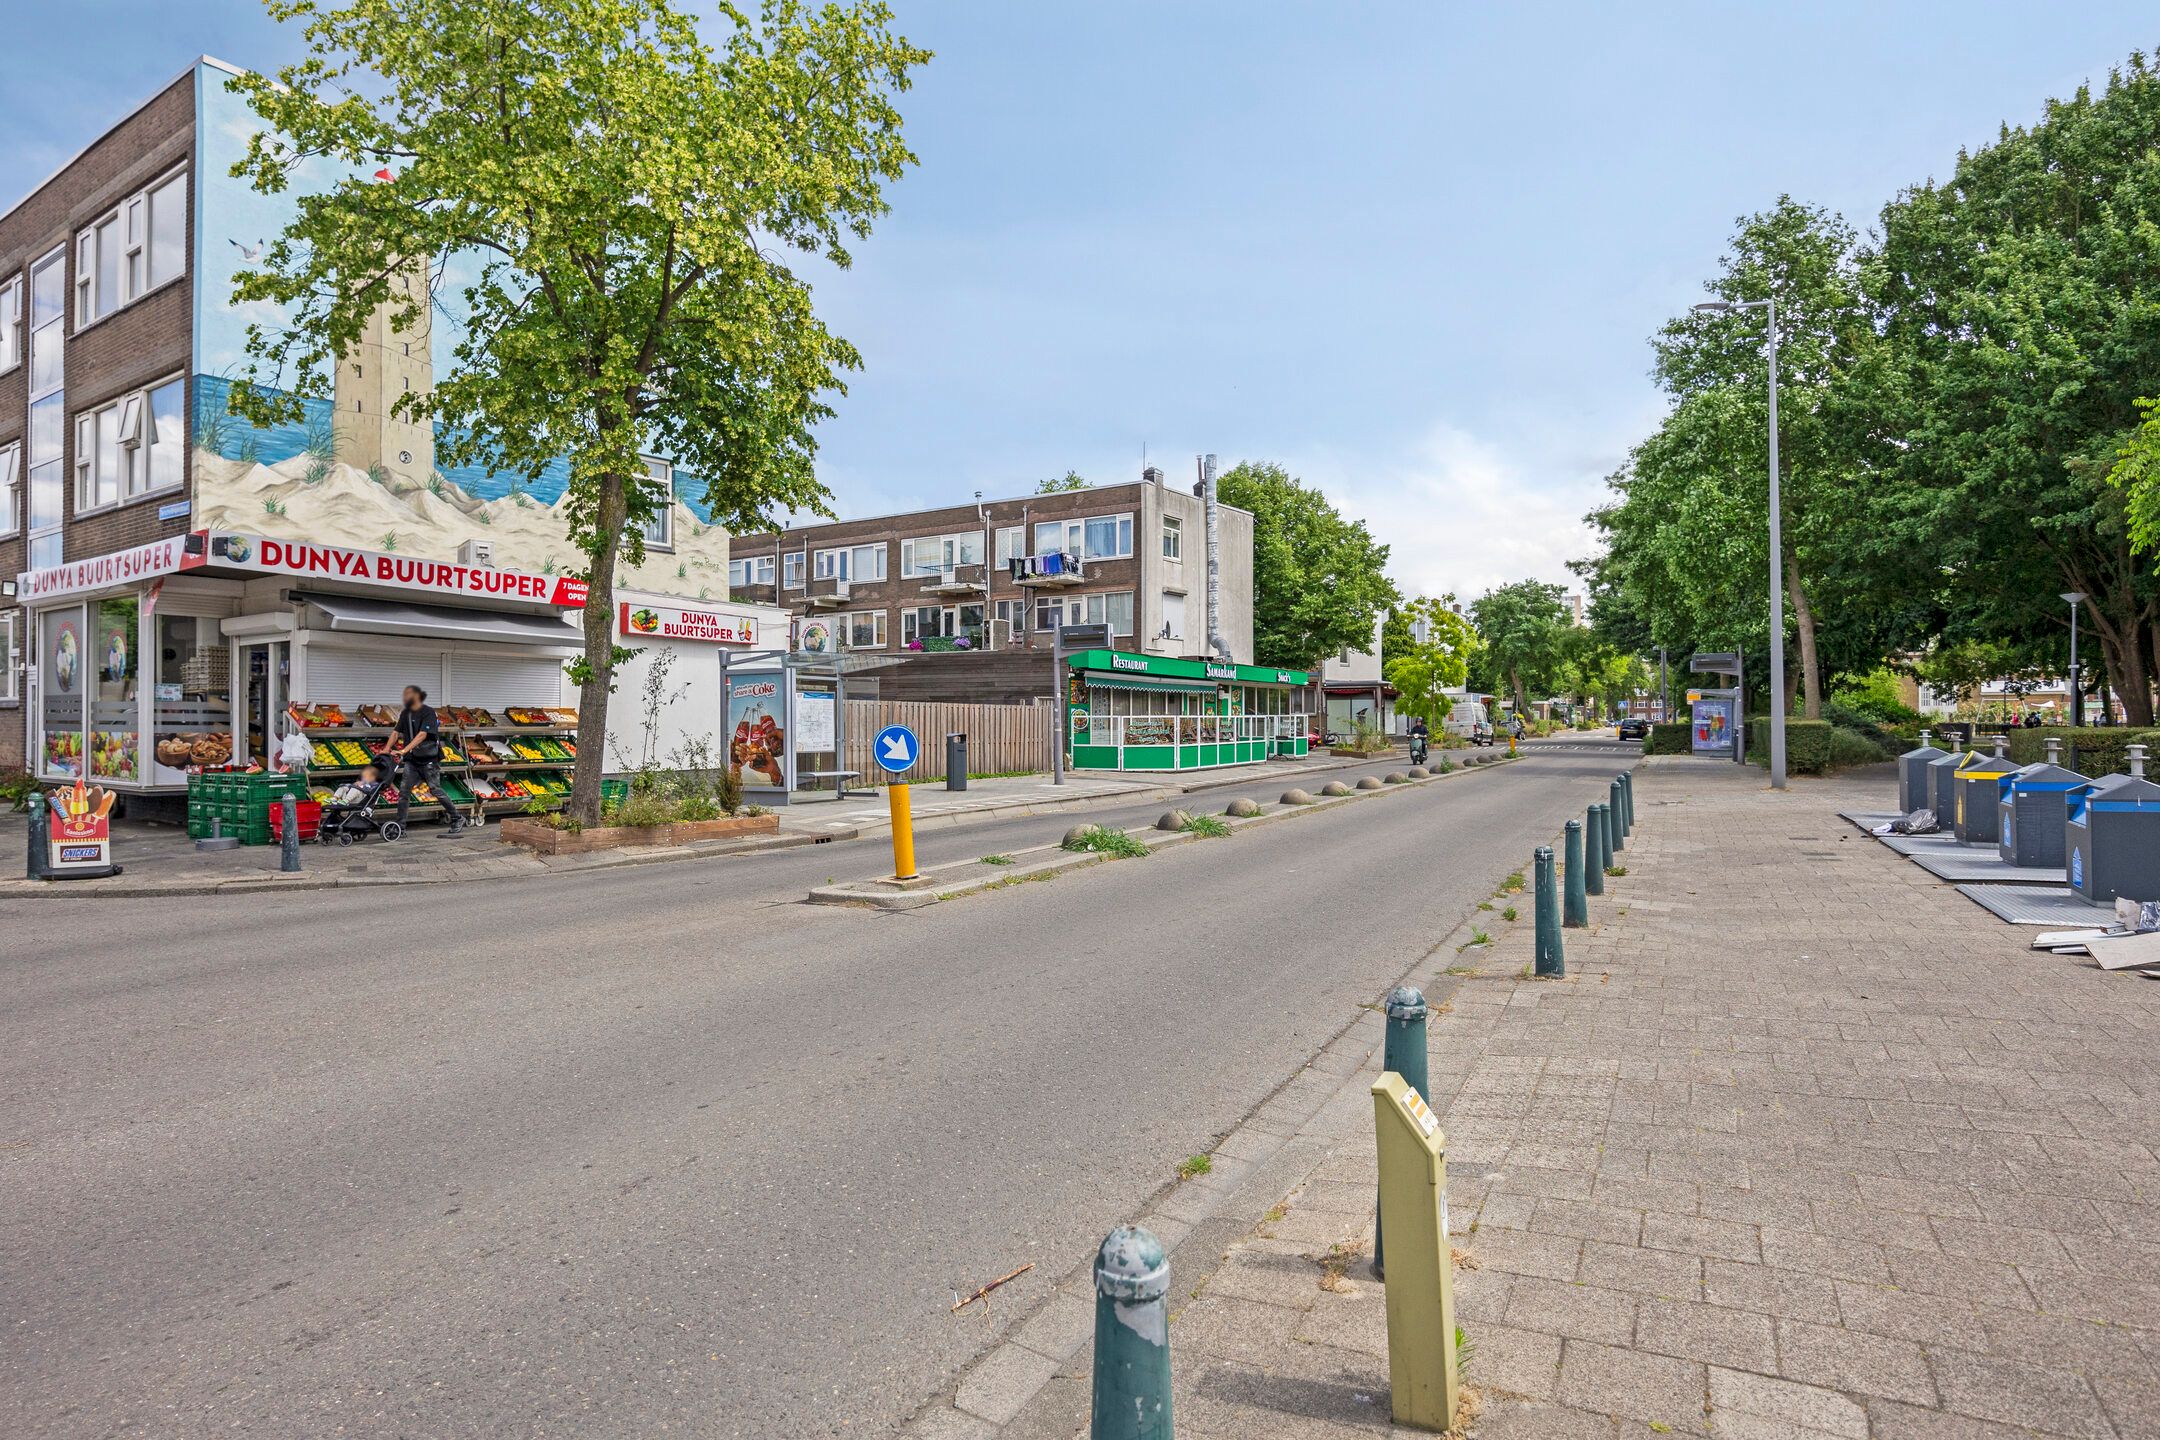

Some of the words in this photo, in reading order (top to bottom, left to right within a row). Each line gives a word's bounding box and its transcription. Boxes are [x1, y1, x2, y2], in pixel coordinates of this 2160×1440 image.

[34, 569, 73, 594] DUNYA
[78, 543, 172, 587] BUURTSUPER
[261, 540, 370, 578] DUNYA
[377, 557, 546, 599] BUURTSUPER
[568, 592, 587, 601] OPEN
[681, 612, 718, 627] DUNYA
[664, 623, 733, 640] BUURTSUPER
[752, 683, 775, 696] Coke
[63, 848, 98, 858] SNICKERS
